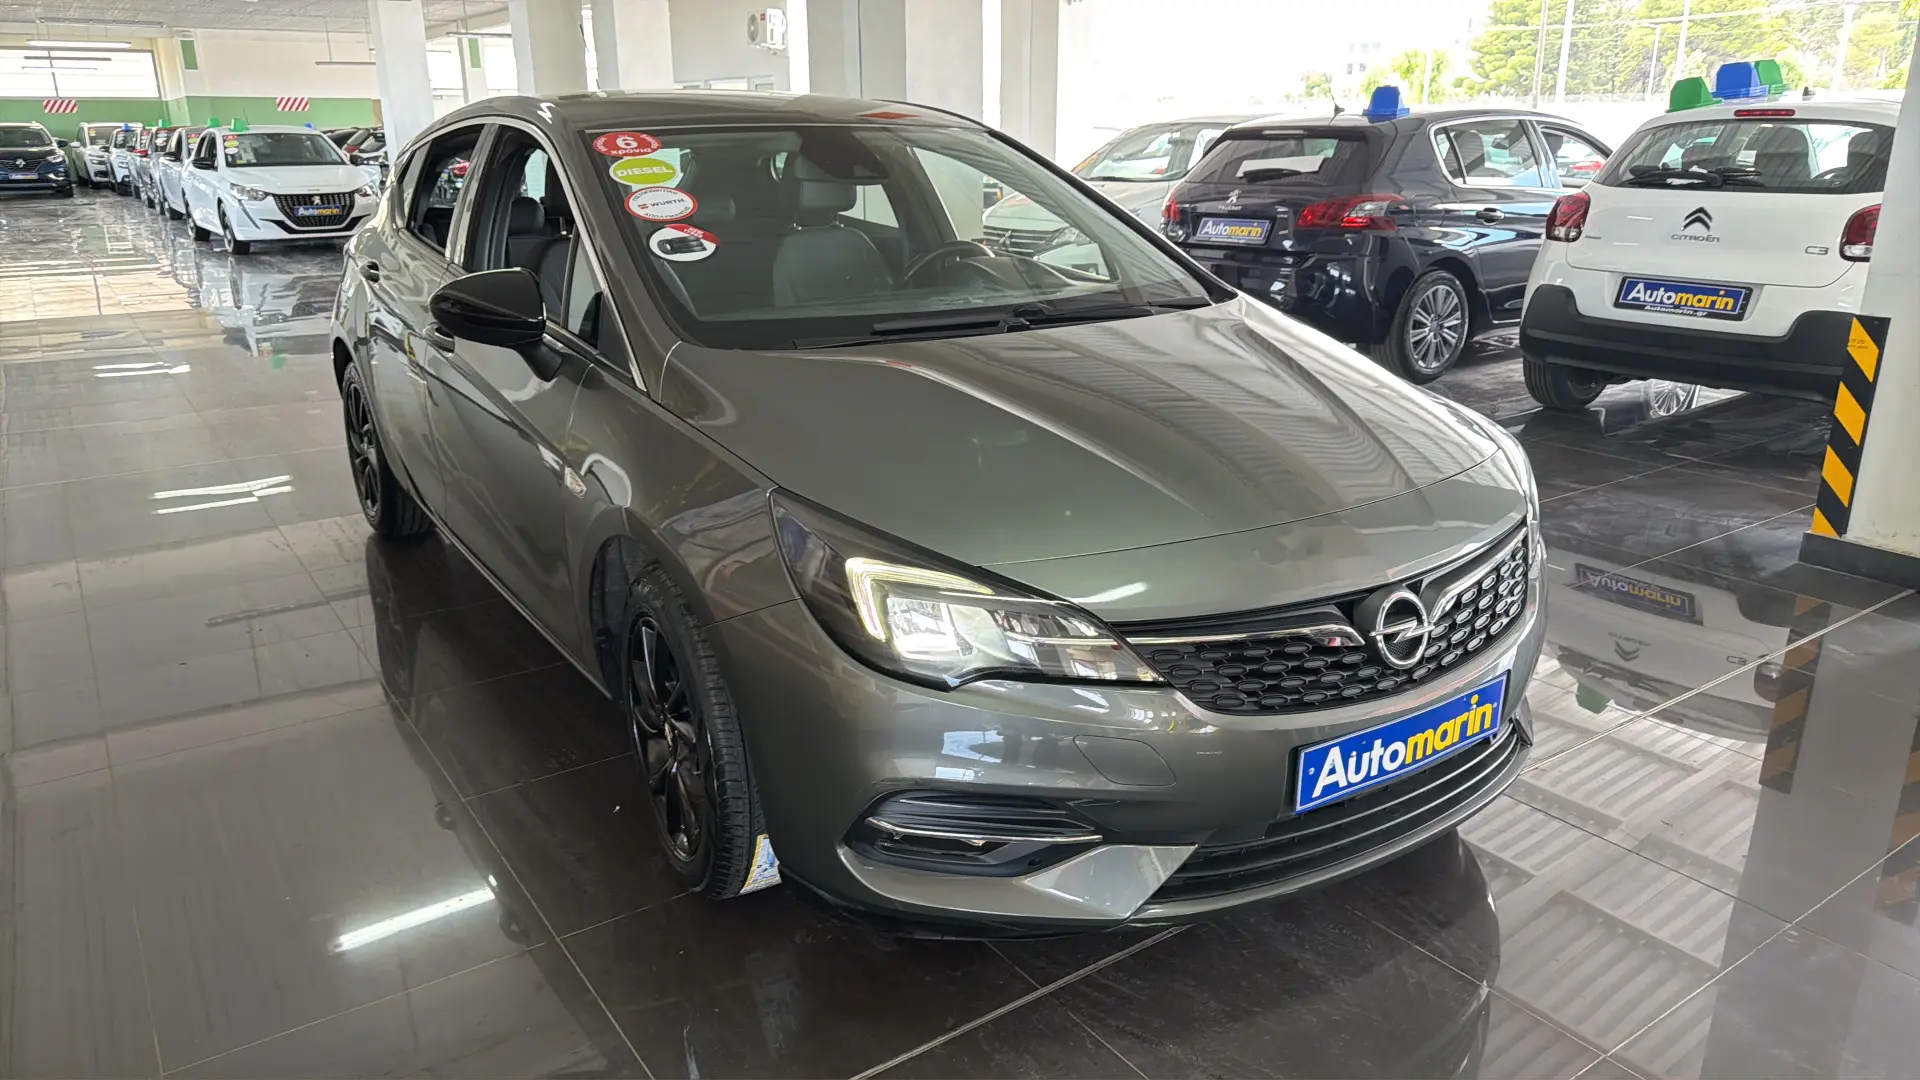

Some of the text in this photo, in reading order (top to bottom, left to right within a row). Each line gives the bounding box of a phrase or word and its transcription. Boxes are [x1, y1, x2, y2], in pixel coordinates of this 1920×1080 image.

[616, 136, 638, 149] 6
[616, 166, 674, 177] DIESEL
[1201, 220, 1263, 237] Automarin
[1805, 245, 1829, 255] C3
[1627, 282, 1735, 311] Automarin
[1643, 304, 1709, 317] Automarin.gr
[1311, 693, 1493, 799] Automarin
